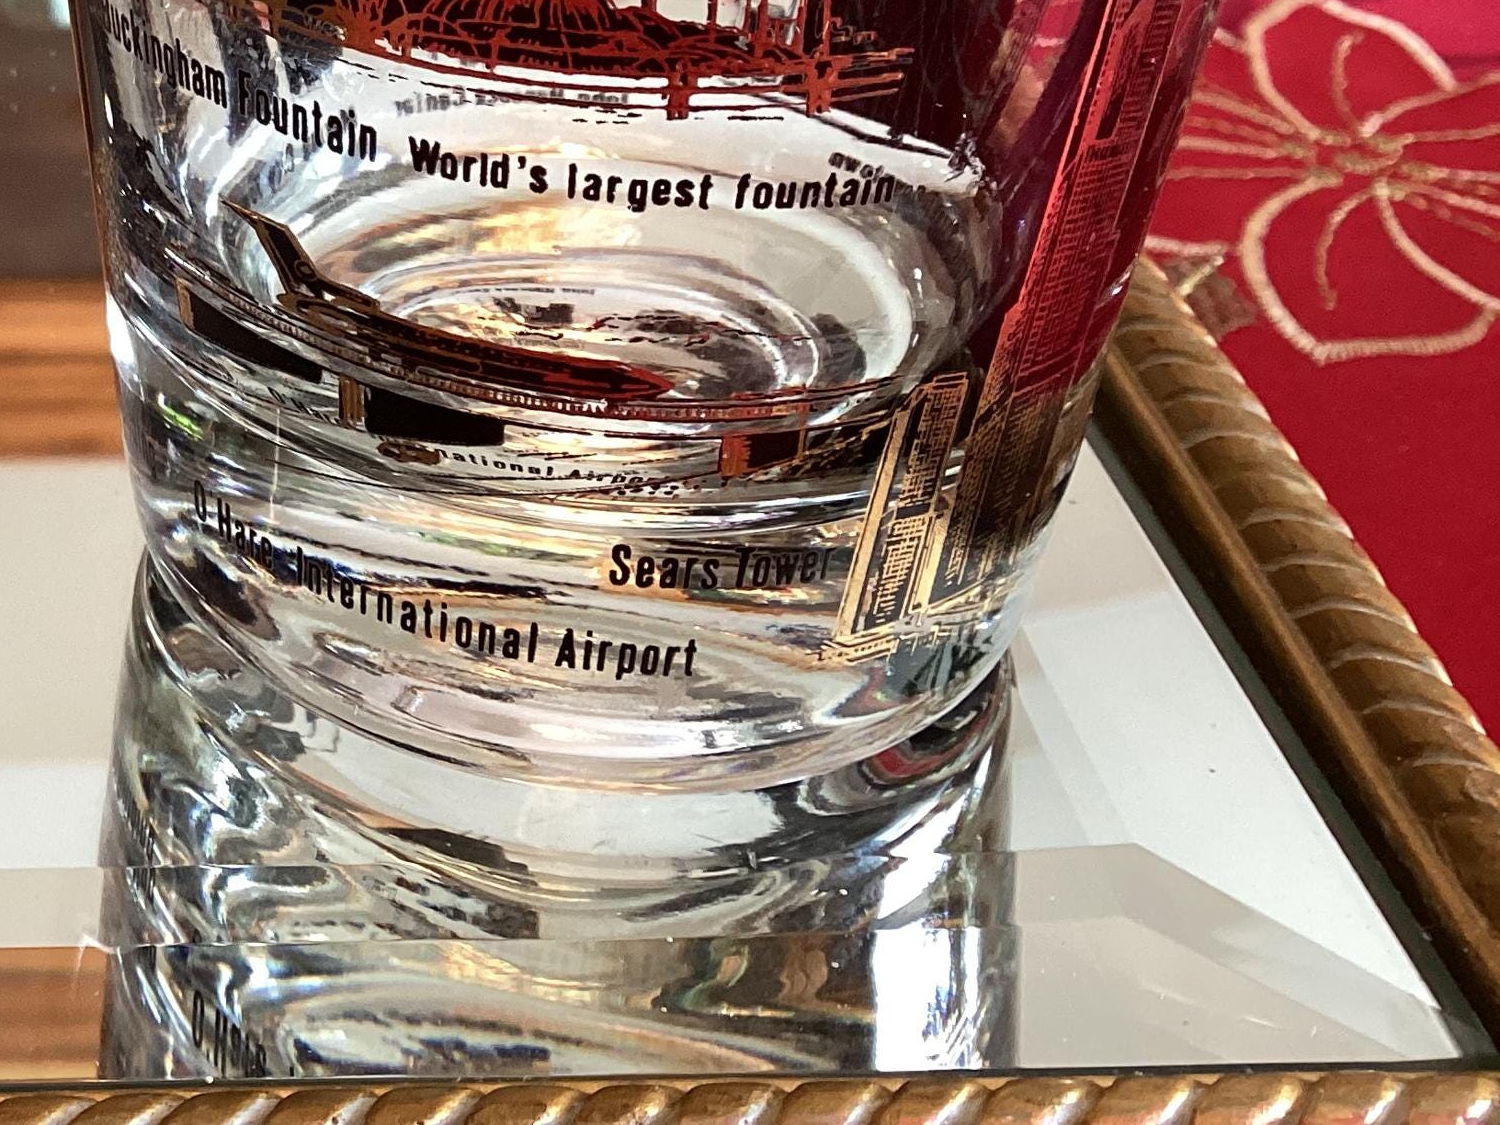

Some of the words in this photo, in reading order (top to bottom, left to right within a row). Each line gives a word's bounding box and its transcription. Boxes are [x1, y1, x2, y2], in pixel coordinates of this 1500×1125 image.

[238, 68, 378, 163] Fountain
[409, 136, 549, 194] World's
[567, 163, 710, 212] largest
[734, 171, 896, 210] fountain
[608, 543, 720, 590] Sears
[734, 545, 837, 589] Tower
[297, 545, 539, 664] International
[554, 627, 698, 680] Airport
